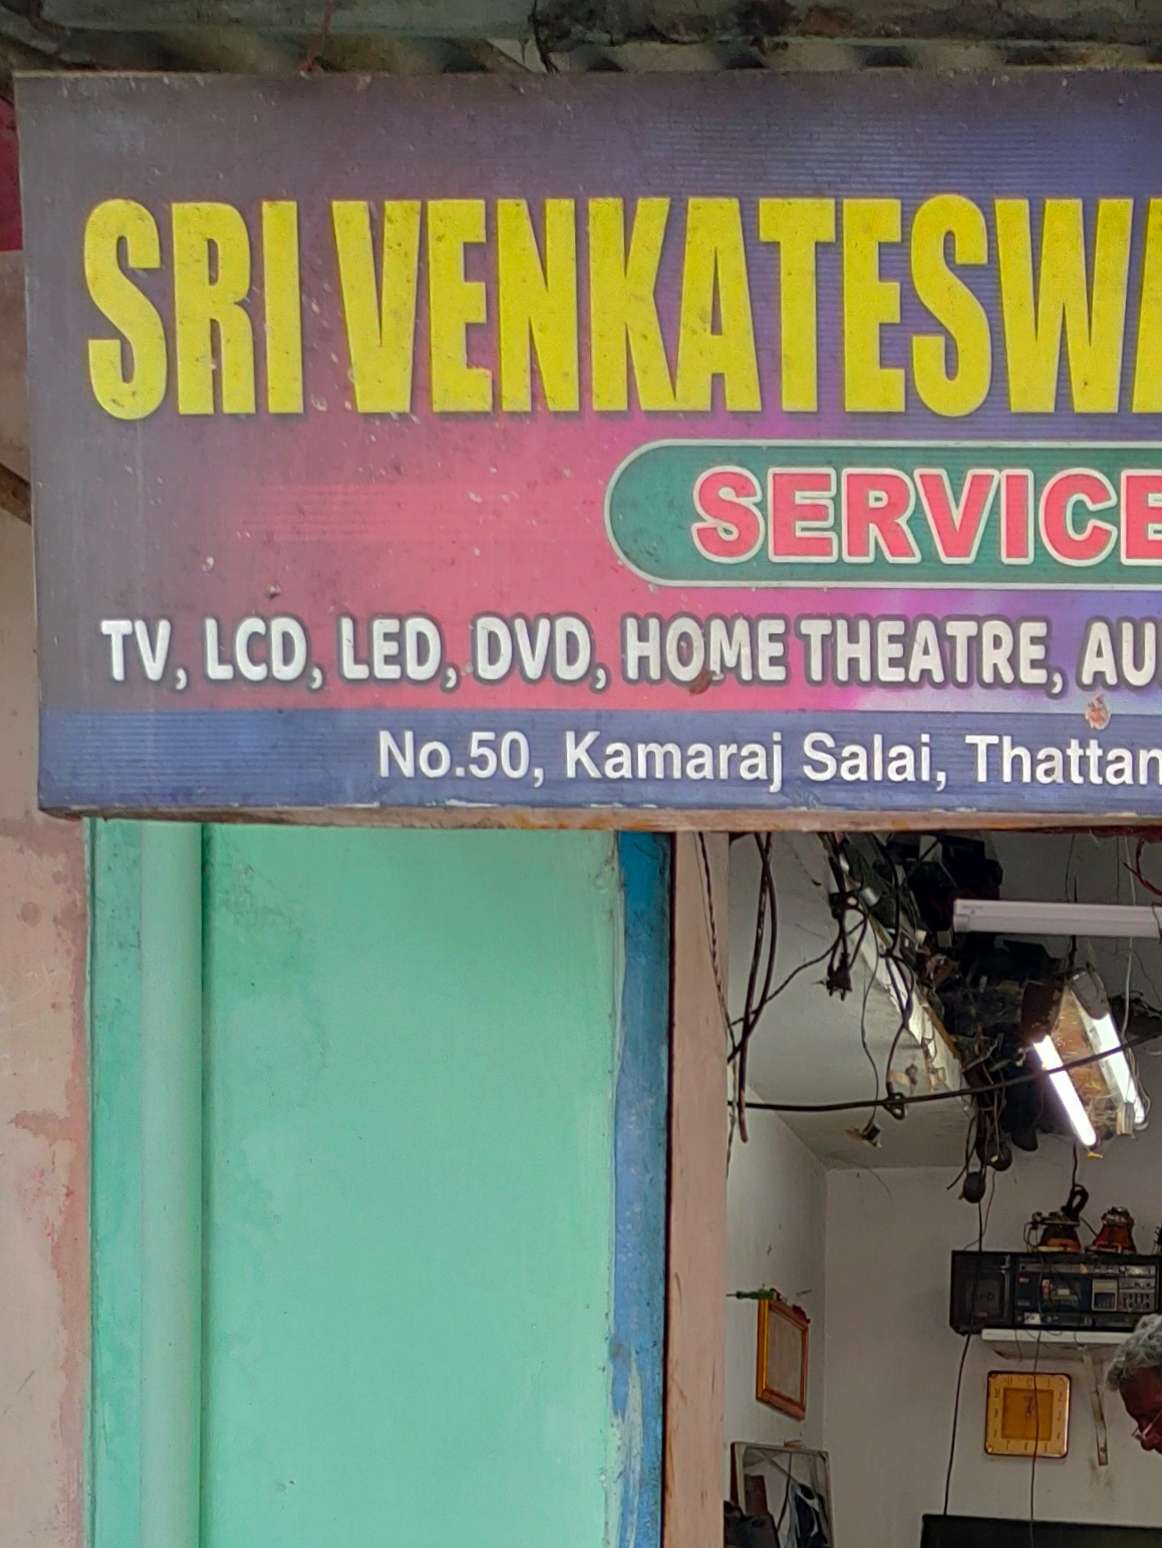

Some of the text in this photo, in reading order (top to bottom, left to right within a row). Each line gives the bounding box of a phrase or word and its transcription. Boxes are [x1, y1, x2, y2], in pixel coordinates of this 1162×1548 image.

[84, 198, 304, 421] SRI
[100, 618, 188, 690] TV,
[203, 617, 324, 690] LCD,
[340, 617, 457, 691] LED,
[471, 617, 608, 691] DVD,
[625, 616, 786, 684] HOME
[802, 618, 1064, 692] THEATRE,
[378, 731, 545, 786] No.50,
[565, 730, 784, 792] Kamaraj
[803, 731, 947, 788] Salai,
